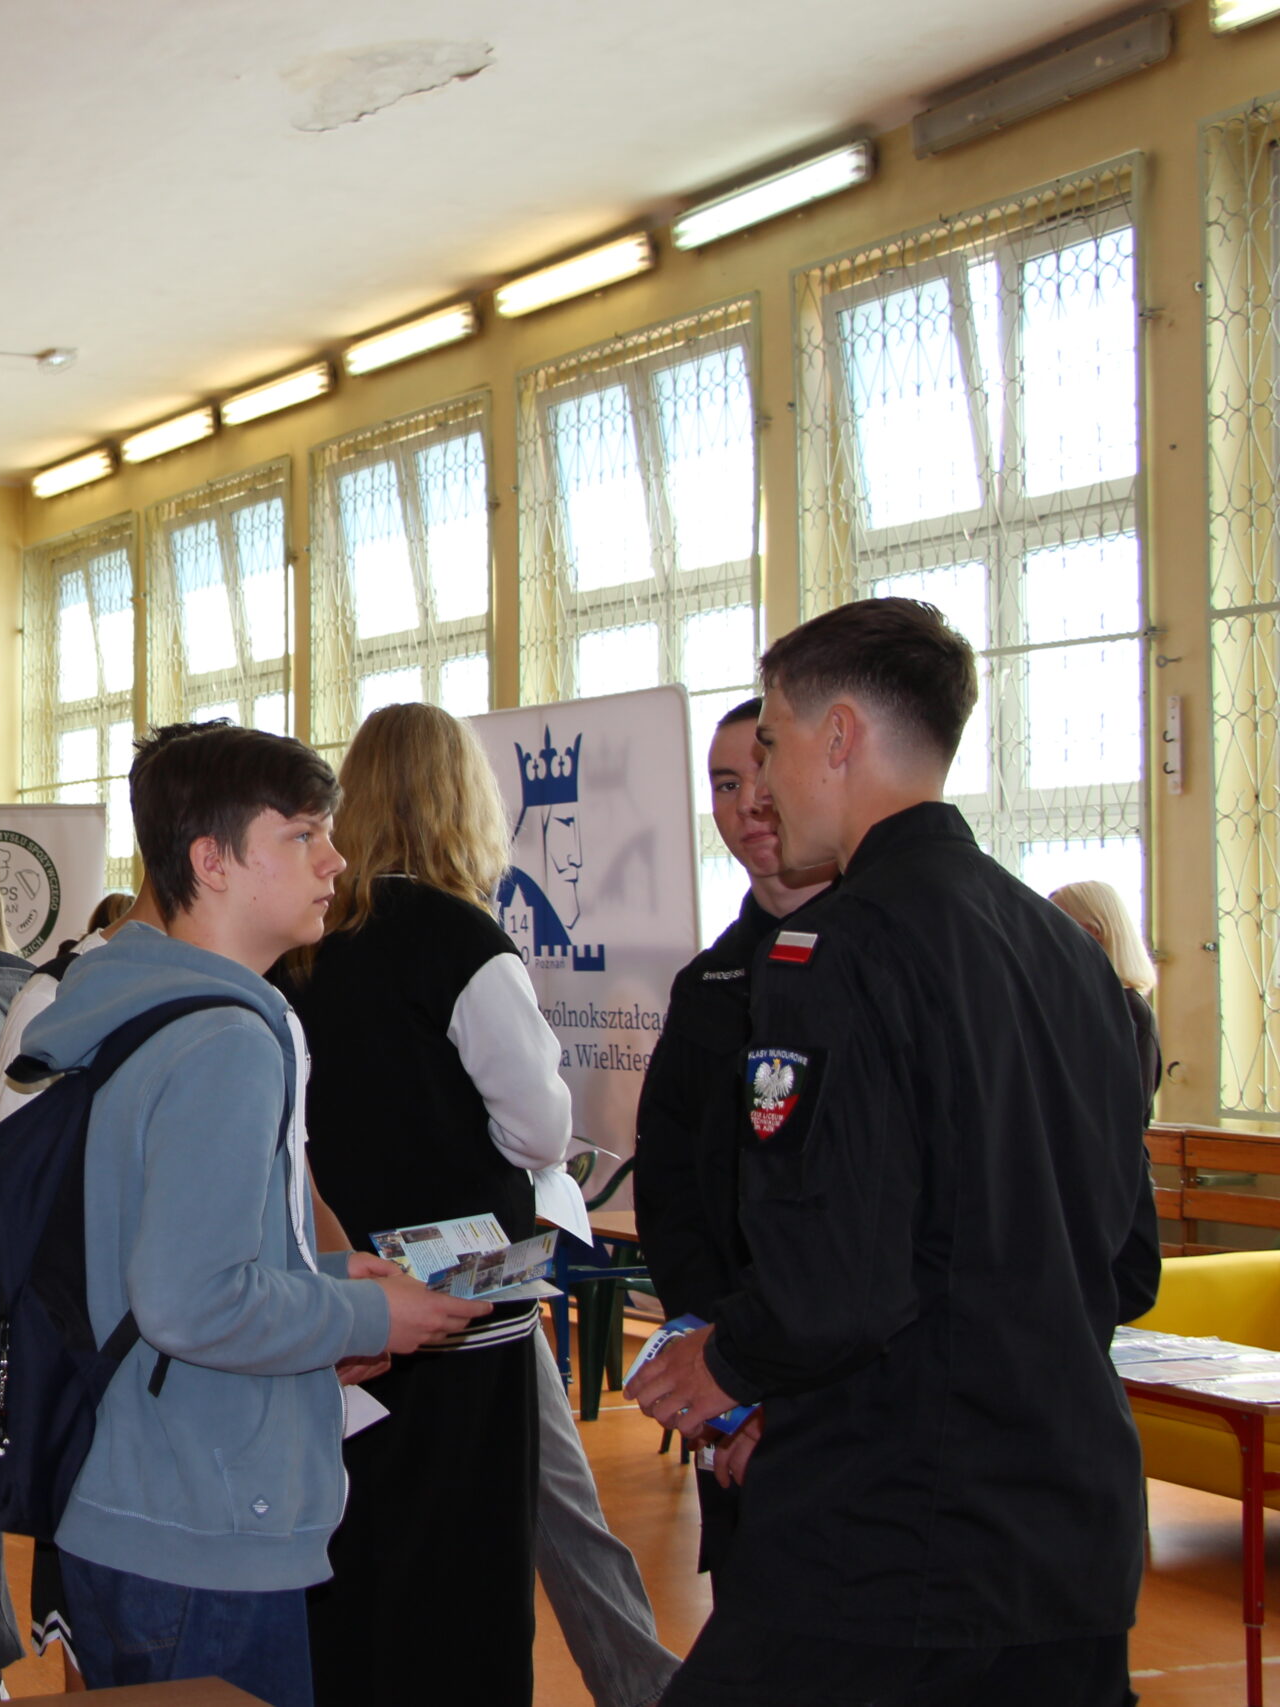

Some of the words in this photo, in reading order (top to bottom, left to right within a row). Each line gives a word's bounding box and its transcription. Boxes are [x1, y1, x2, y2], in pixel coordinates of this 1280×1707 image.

[510, 914, 529, 933] 14
[521, 946, 530, 965] 0
[539, 1001, 669, 1036] gólnokształcą
[575, 1043, 651, 1072] Wielkieg
